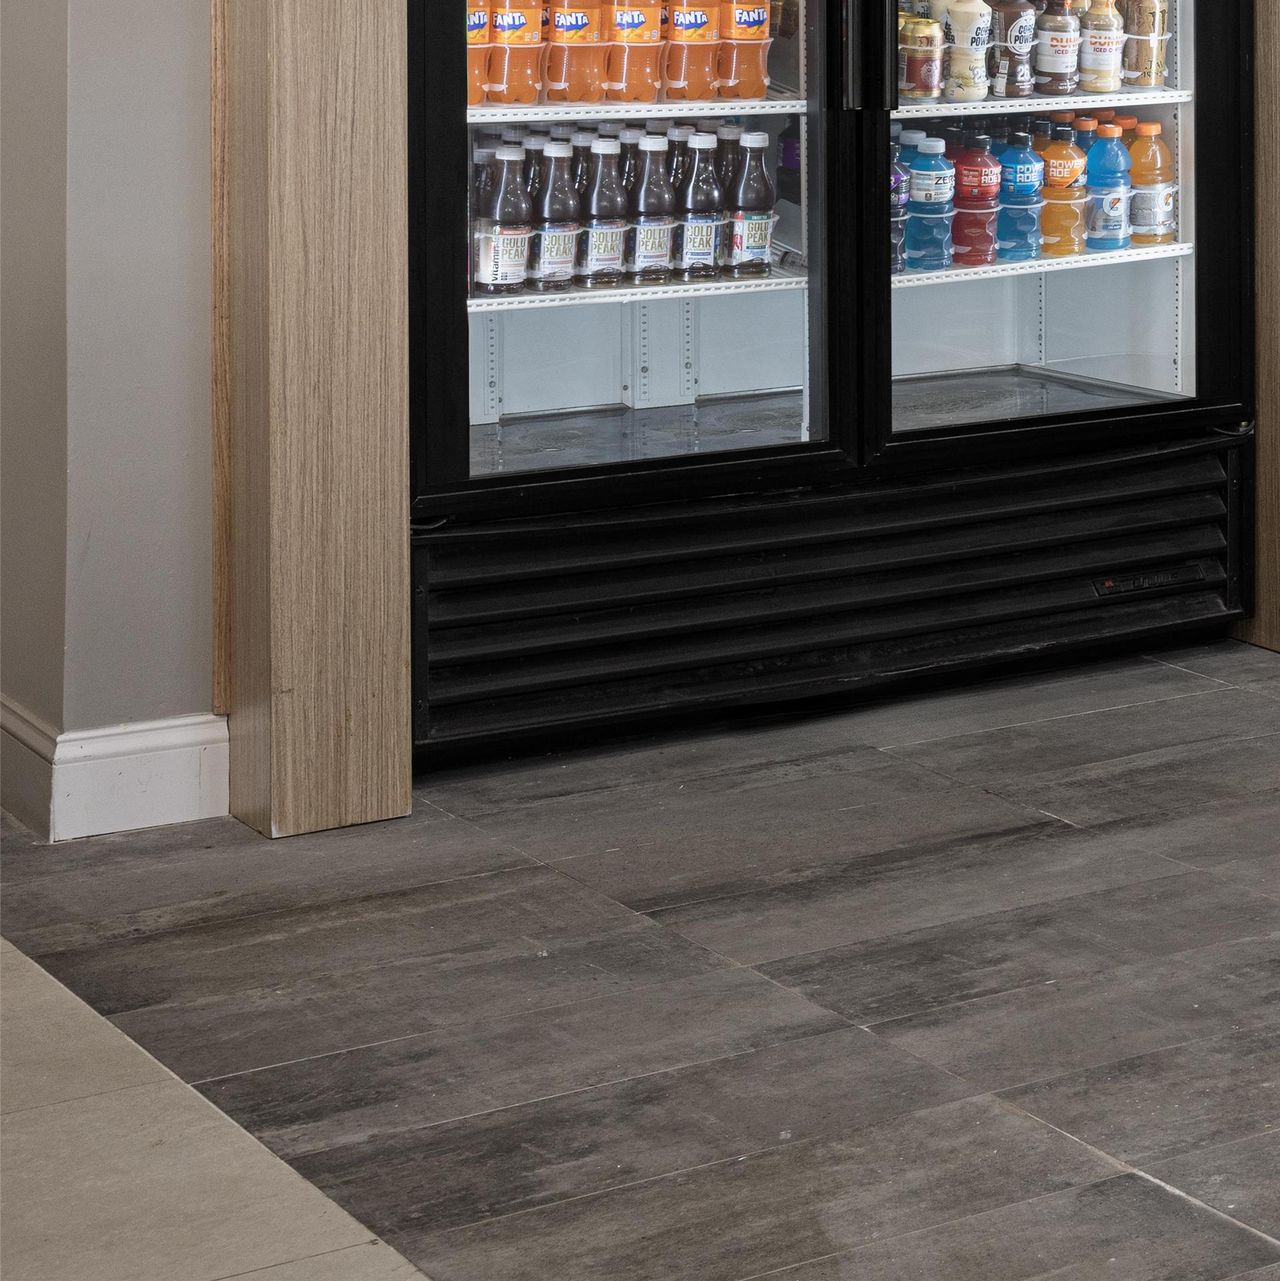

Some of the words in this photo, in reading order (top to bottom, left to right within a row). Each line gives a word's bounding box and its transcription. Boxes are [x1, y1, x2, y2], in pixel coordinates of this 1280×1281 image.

[467, 11, 488, 26] ANTA
[493, 11, 527, 26] FANTA
[554, 12, 589, 26] FANTA
[674, 10, 708, 24] FANTA
[735, 8, 768, 23] FANTA
[1049, 168, 1071, 178] ADE
[747, 233, 769, 243] PEAK
[502, 248, 526, 259] PEAK
